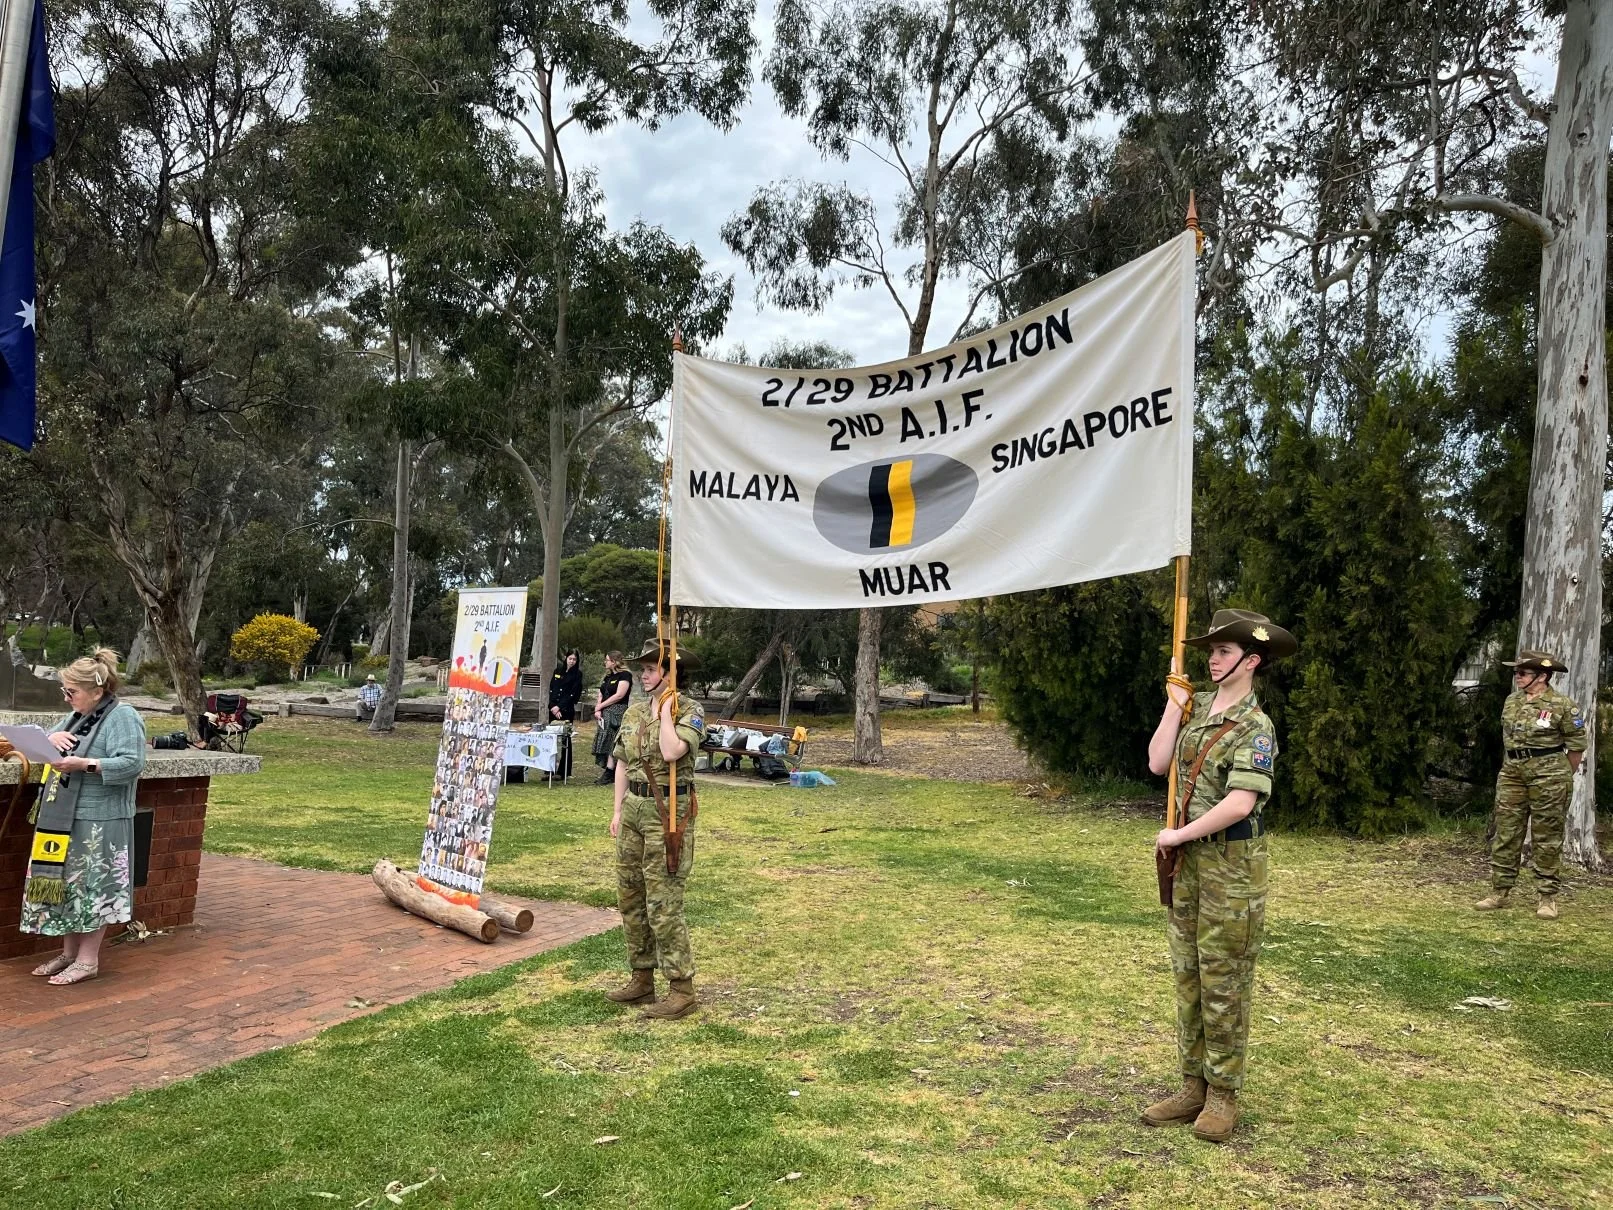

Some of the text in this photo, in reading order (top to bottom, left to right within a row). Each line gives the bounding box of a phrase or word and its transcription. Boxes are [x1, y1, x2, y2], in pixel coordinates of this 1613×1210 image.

[761, 307, 1074, 409] 2/29 BATTALION
[828, 387, 994, 452] 2ND A.I.F.
[989, 385, 1174, 475] SINGAPORE
[688, 469, 801, 503] MALAYA
[857, 560, 952, 598] MUAR
[464, 604, 515, 616] 2/29 BATTALION
